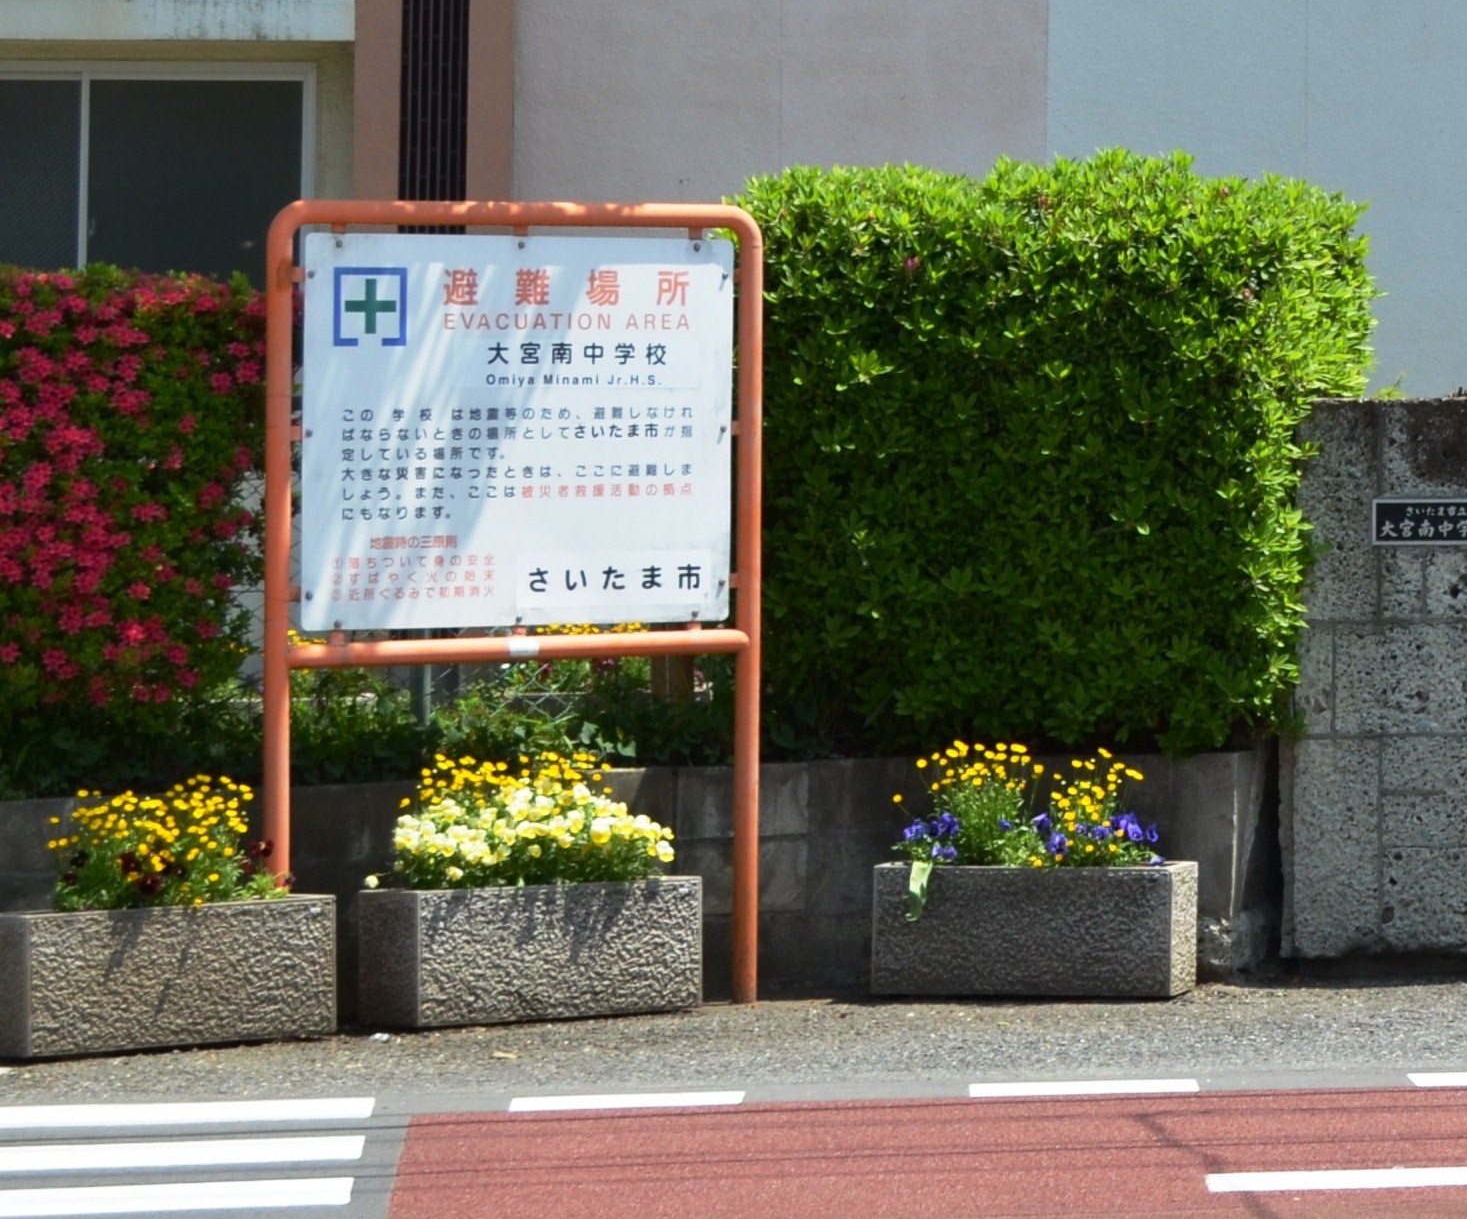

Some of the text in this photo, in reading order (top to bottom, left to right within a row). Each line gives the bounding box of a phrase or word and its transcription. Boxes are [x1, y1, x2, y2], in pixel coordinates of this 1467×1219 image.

[443, 268, 690, 306] 避難場所
[443, 313, 690, 330] EVACUATION AREA
[487, 342, 667, 365] 大宮南中学校
[486, 374, 535, 388] Omiya
[543, 374, 599, 385] Minami
[342, 507, 451, 520] にもなります。
[1406, 506, 1467, 517] さいたま市立
[529, 564, 701, 592] さいたま市
